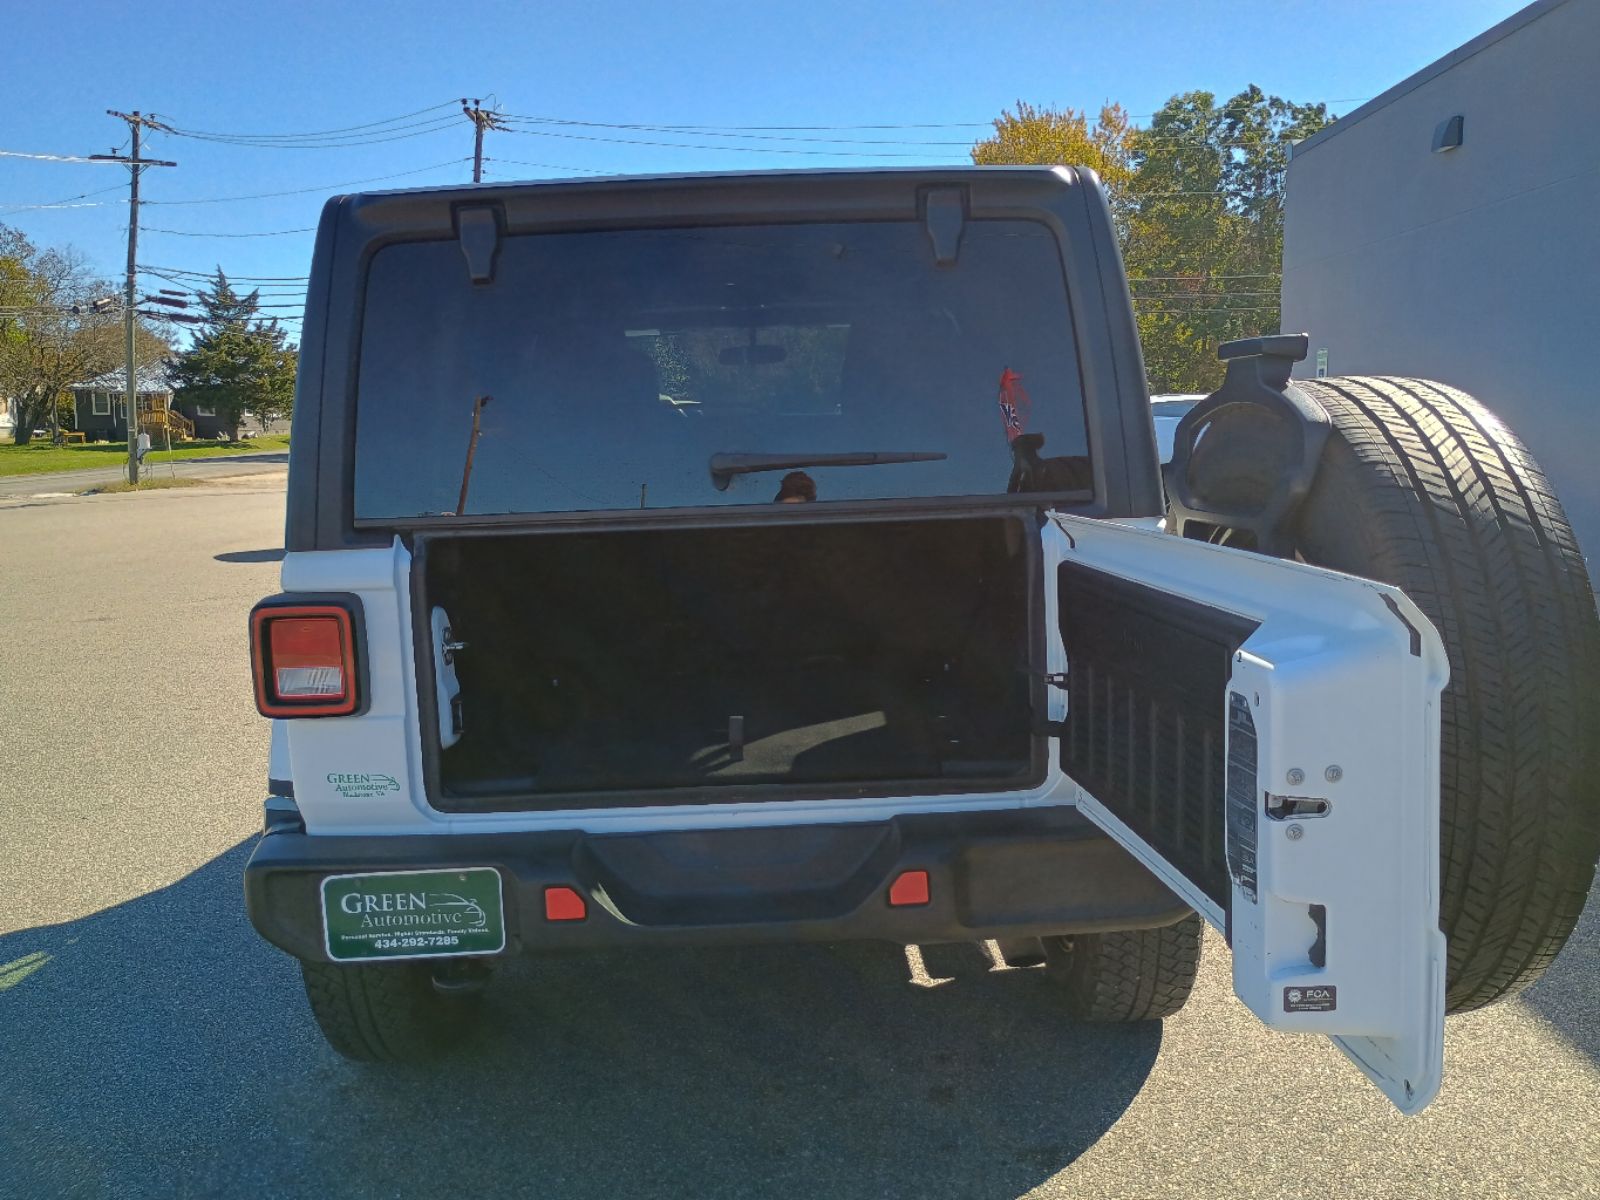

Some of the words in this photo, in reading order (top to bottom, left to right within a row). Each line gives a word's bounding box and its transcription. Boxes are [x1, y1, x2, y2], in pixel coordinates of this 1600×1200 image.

[327, 773, 370, 784] GREEN
[336, 782, 388, 792] Automotive
[341, 892, 426, 914] GREEN
[361, 908, 462, 928] Automotive
[374, 935, 459, 949] 434-292-7285
[1306, 989, 1330, 998] FCA
